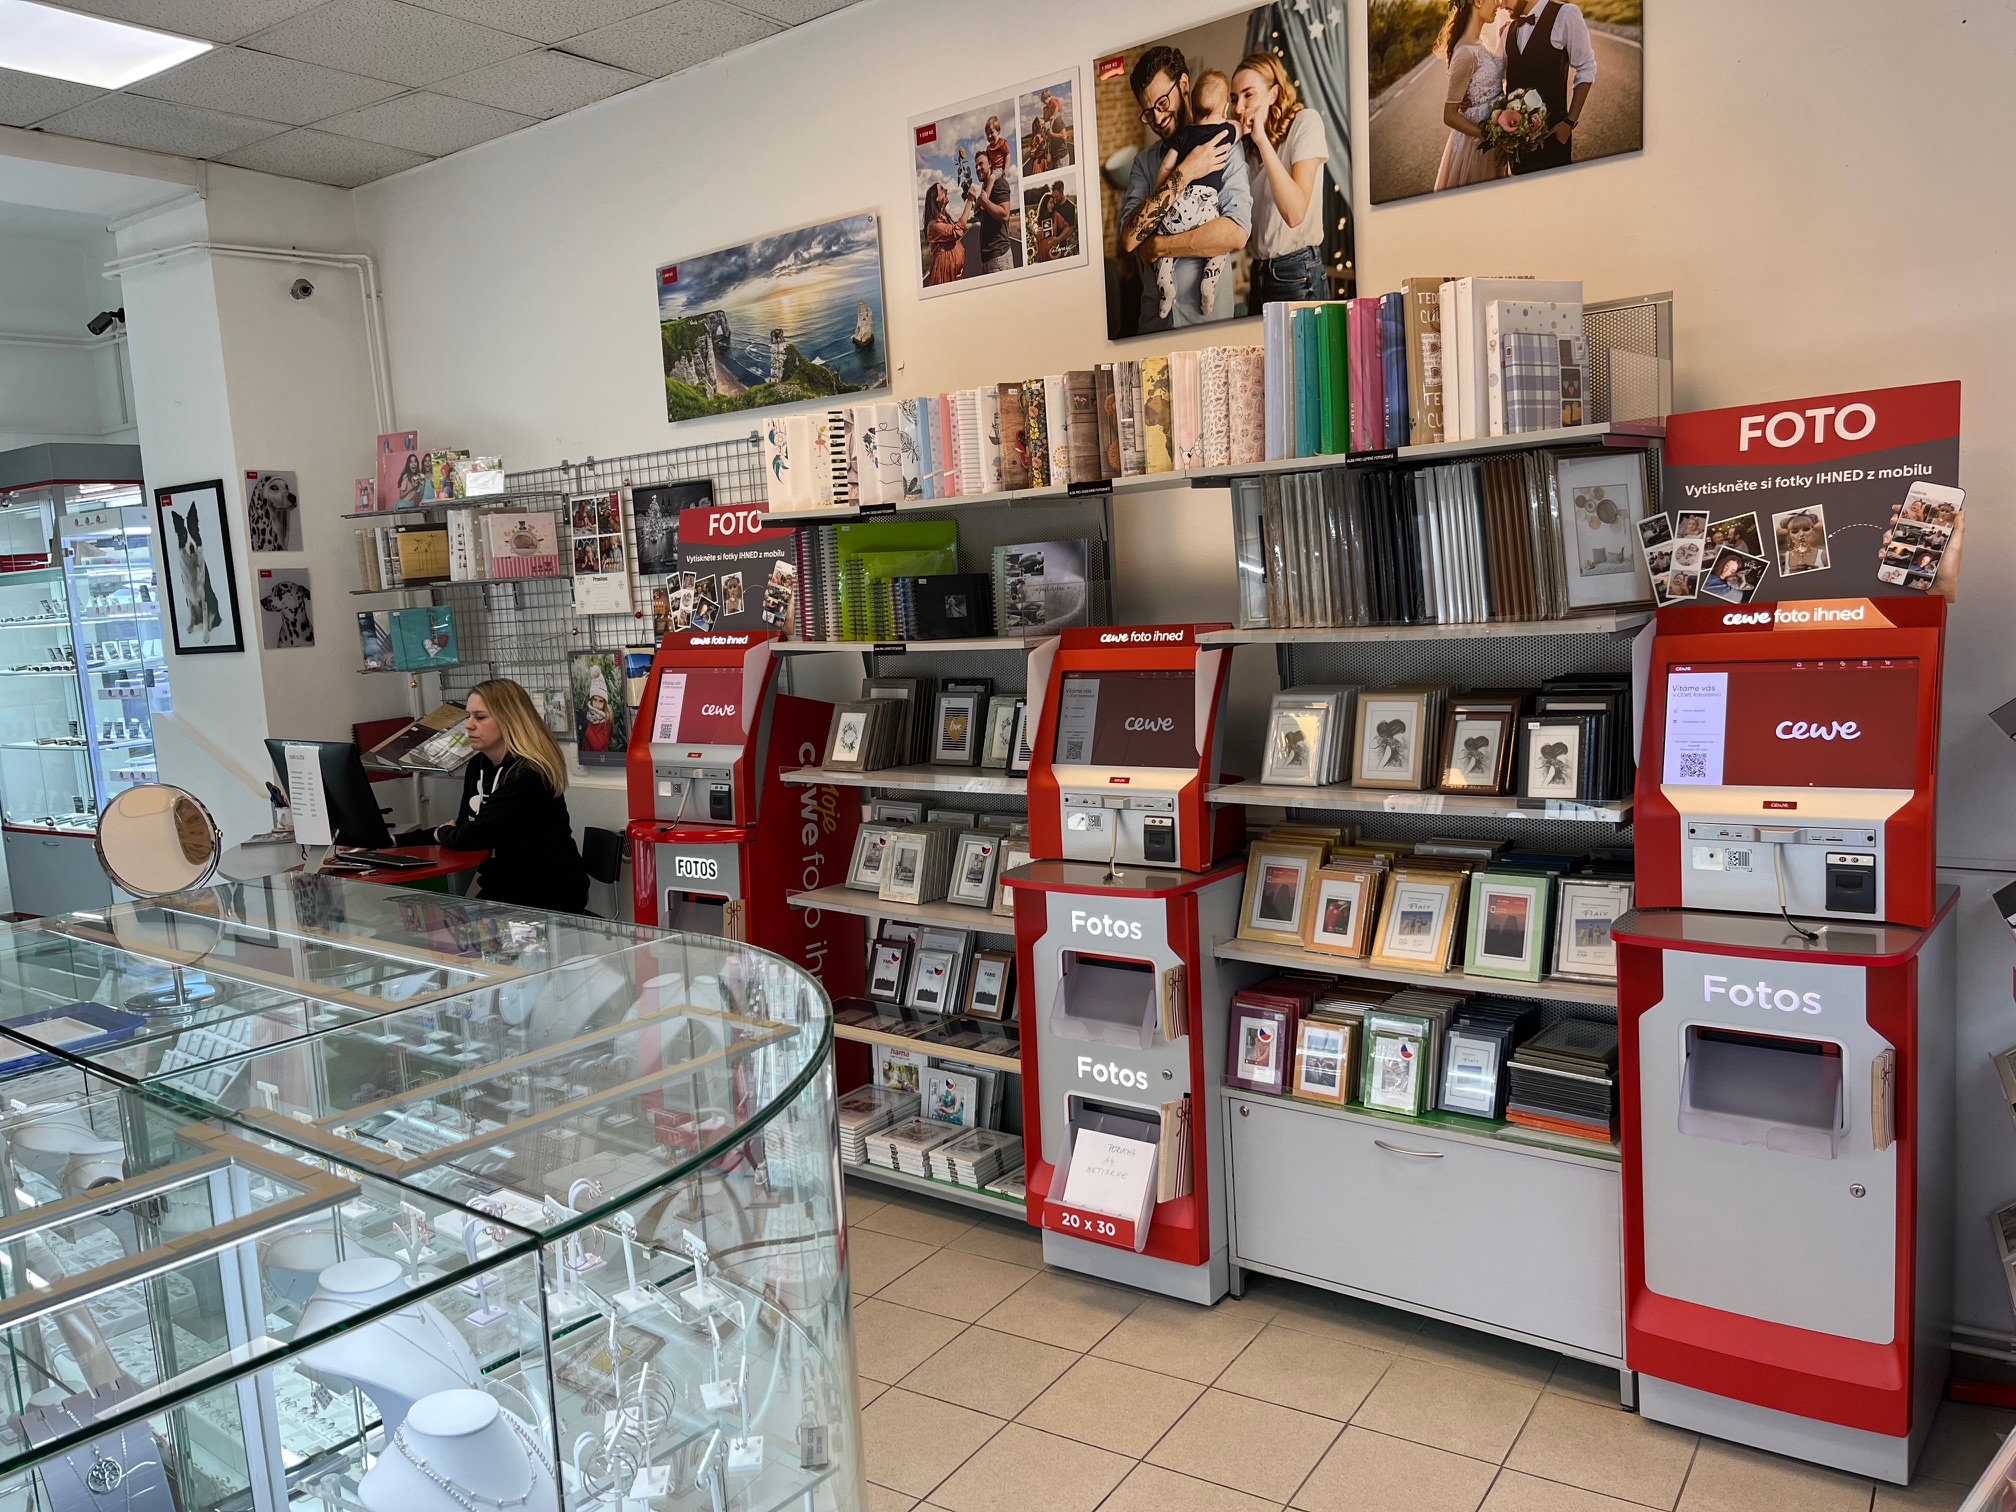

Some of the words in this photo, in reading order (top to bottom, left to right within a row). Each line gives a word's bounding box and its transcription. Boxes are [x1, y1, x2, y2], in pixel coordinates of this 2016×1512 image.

[1738, 402, 1876, 452] FOTO
[1685, 479, 1758, 497] Vytiskněte
[1760, 477, 1772, 490] si
[1774, 473, 1813, 489] fotky
[1815, 469, 1864, 485] IHNED
[1867, 471, 1875, 480] z
[1878, 463, 1933, 479] mobilu
[708, 509, 762, 537] FOTO
[686, 552, 716, 564] Vytiskněte
[717, 553, 722, 561] si
[722, 551, 738, 562] fotky
[739, 550, 758, 560] IHNED
[763, 549, 785, 558] mobilu
[1722, 611, 1771, 626] cewe
[1773, 608, 1810, 623] foto
[1813, 605, 1865, 622] ihned
[690, 637, 711, 645] cewe
[711, 635, 727, 645] foto
[726, 635, 749, 645] ihned
[1100, 632, 1129, 643] cewe
[1130, 631, 1152, 642] foto
[1153, 629, 1184, 642] ihned
[1701, 684, 1716, 692] vás
[701, 703, 736, 717] cewe
[1124, 715, 1175, 732] cewe
[1775, 720, 1861, 741] cewe
[677, 858, 717, 878] FOTOS
[1407, 902, 1432, 910] Flair
[1581, 909, 1609, 918] Flair
[1071, 910, 1143, 940] Fotos
[1703, 974, 1822, 1015] Fotos
[1077, 1055, 1149, 1090] Fotos
[1107, 1143, 1136, 1156] PORUCHA
[1103, 1156, 1115, 1166] A4
[1086, 1166, 1129, 1180] NETISKNE
[1061, 1212, 1080, 1228] 20
[1084, 1219, 1093, 1231] x
[1096, 1220, 1116, 1236] 30
